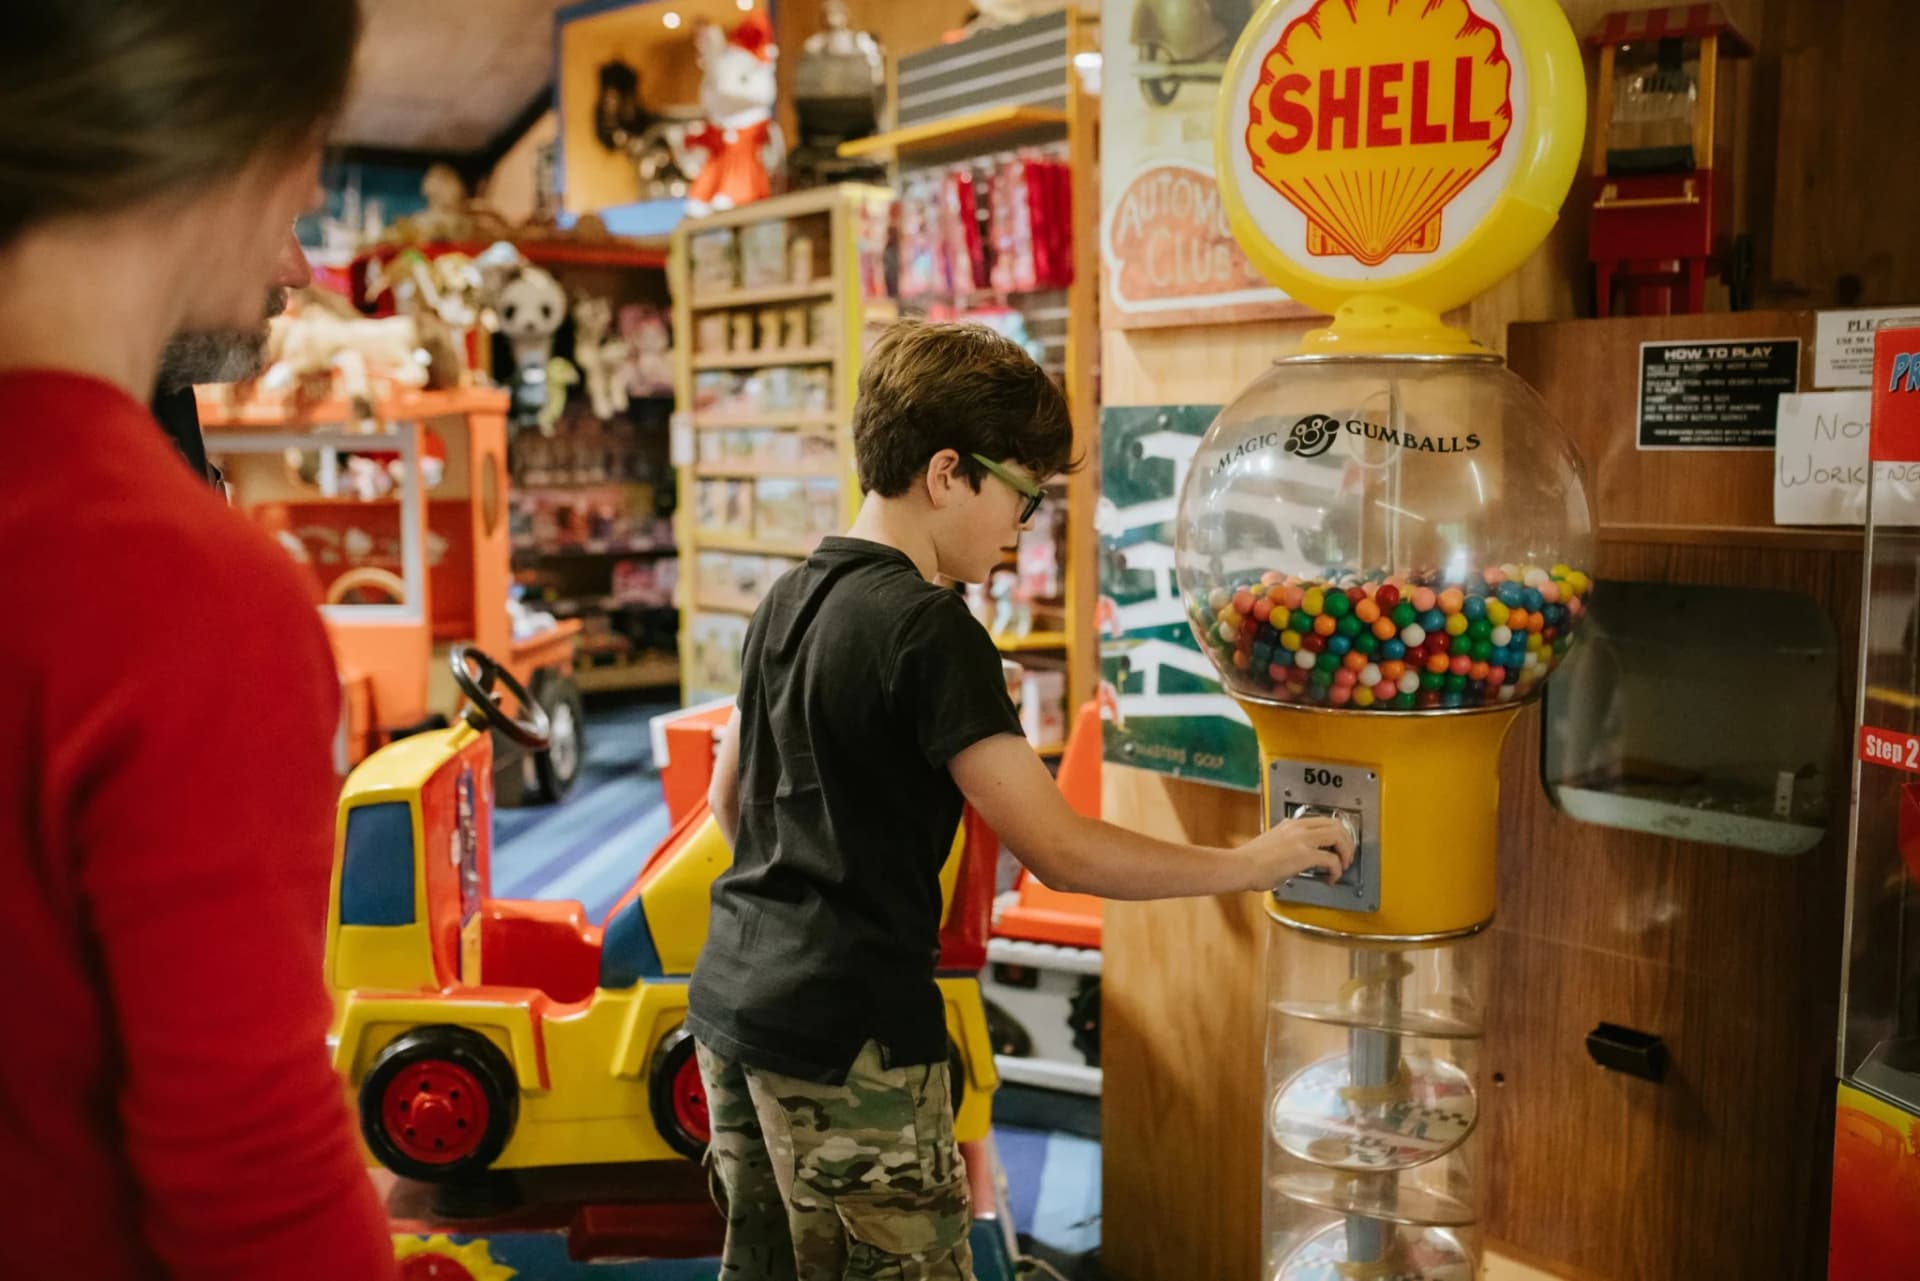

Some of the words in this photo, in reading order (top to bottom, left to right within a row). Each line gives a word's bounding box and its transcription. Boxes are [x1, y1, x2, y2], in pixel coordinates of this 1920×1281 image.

[1266, 56, 1491, 155] SHELL
[1145, 226, 1232, 288] CLUB
[1664, 349, 1701, 361] HOW
[1708, 348, 1728, 360] TO
[1732, 346, 1773, 358] PLAY
[1814, 413, 1872, 442] NO
[1217, 432, 1278, 473] MAGIC
[1345, 420, 1481, 453] GUMBALLS
[1193, 752, 1225, 769] GOLF
[1866, 734, 1903, 764] Step
[1905, 738, 1919, 769] 2
[1304, 767, 1343, 788] 50c
